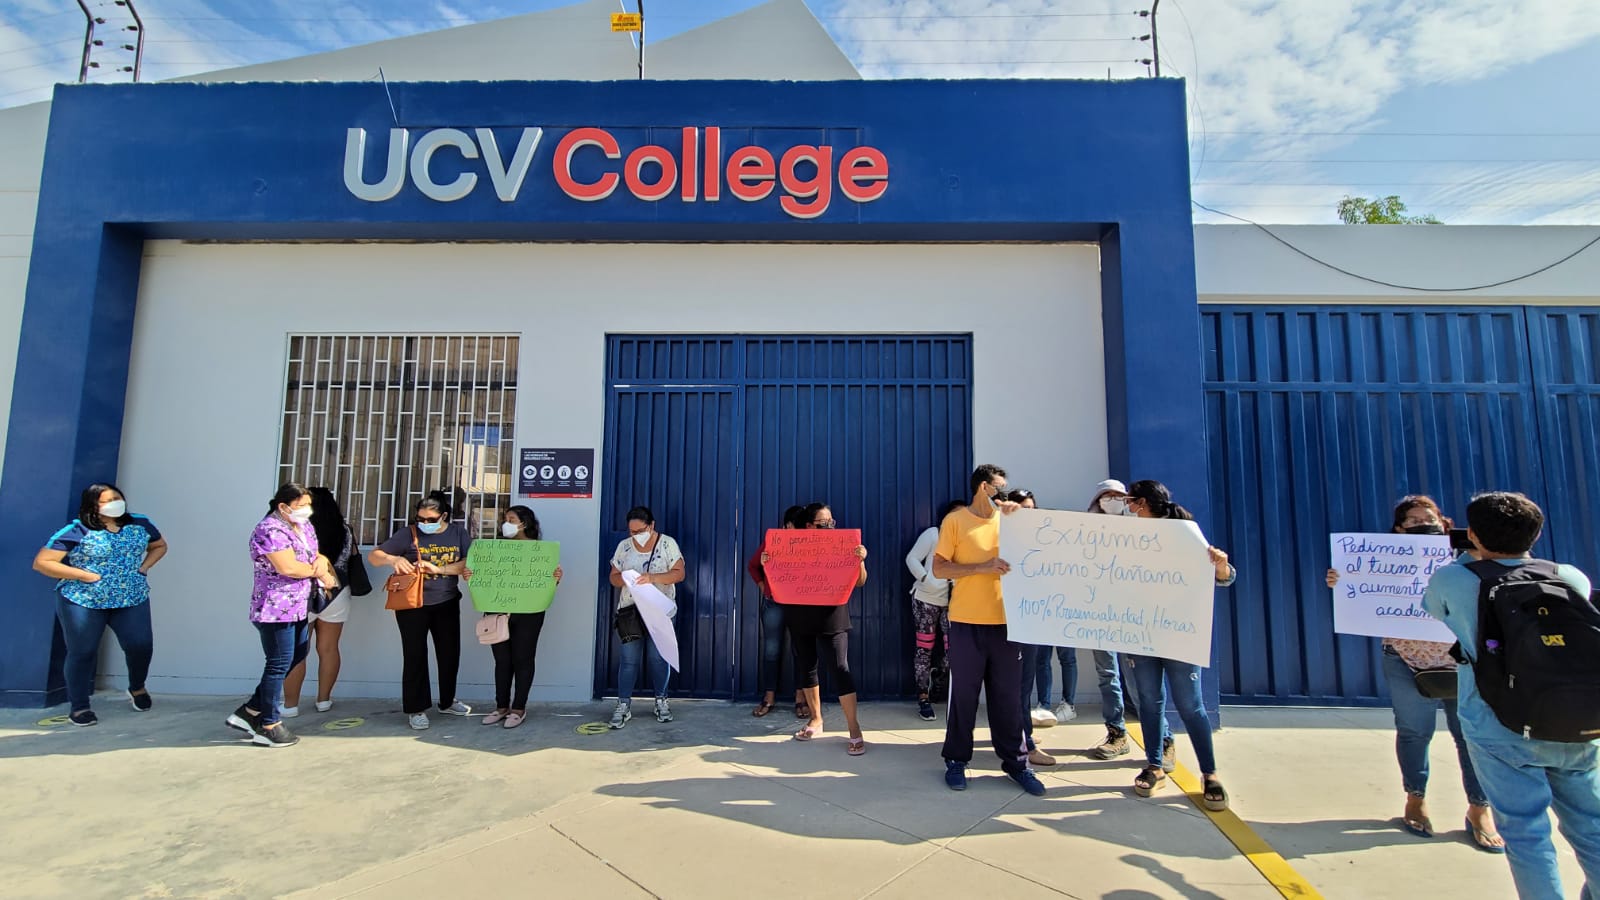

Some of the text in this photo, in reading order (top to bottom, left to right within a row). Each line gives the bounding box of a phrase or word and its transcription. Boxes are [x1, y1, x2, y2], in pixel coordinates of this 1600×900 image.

[343, 126, 889, 219] UCV College
[1035, 517, 1162, 560] Exigimos
[1337, 536, 1453, 562] Pedimos regr
[1018, 549, 1188, 587] Turno Mañana
[1346, 556, 1362, 574] al
[1368, 556, 1419, 575] turno
[1085, 585, 1097, 603] y
[1346, 583, 1357, 599] y
[1153, 604, 1197, 634] Horas
[1540, 634, 1566, 647] CAT
